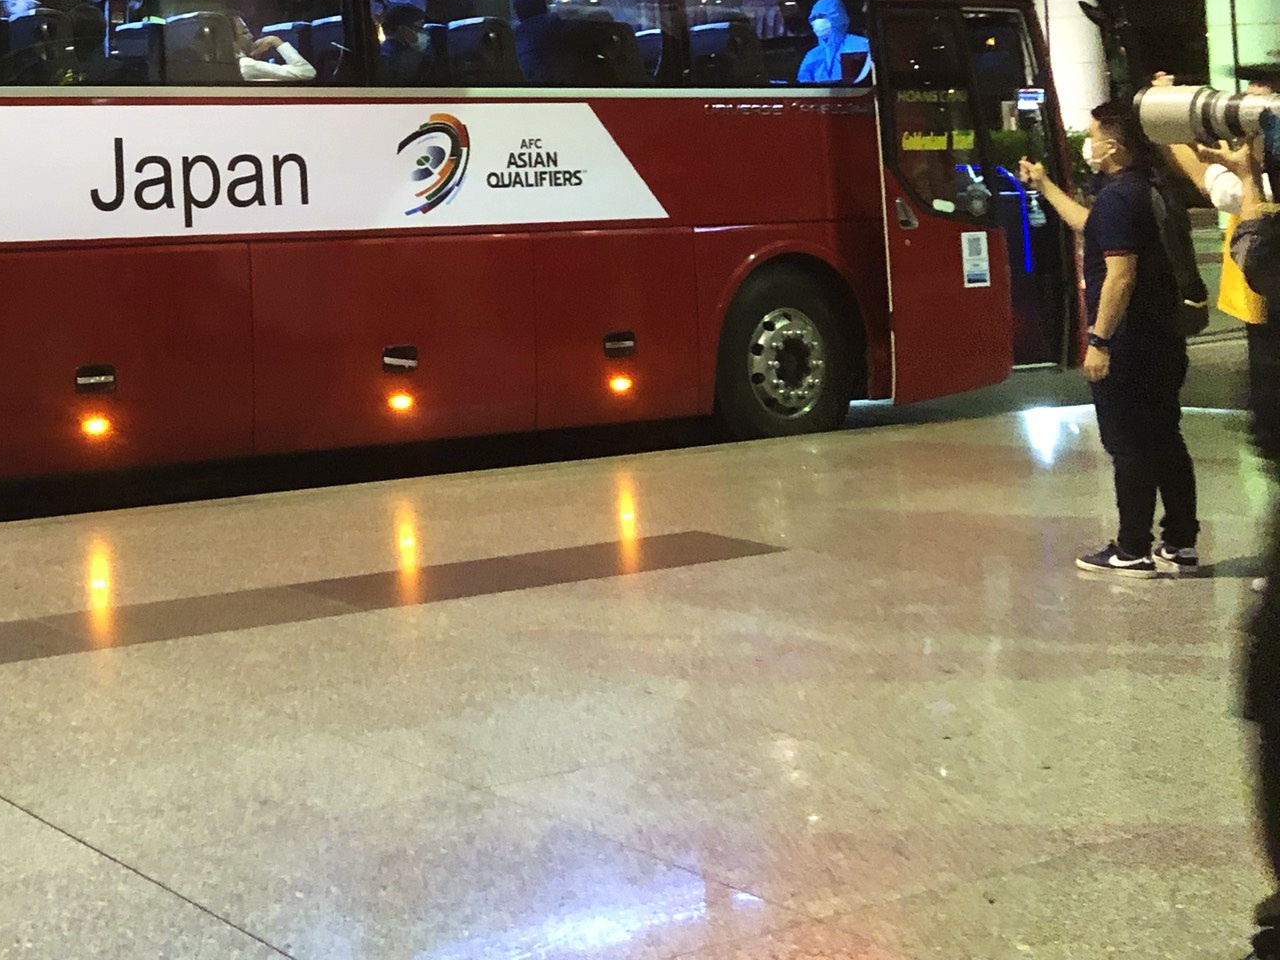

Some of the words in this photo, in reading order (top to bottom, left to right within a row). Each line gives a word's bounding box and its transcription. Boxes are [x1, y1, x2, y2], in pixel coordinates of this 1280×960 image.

[520, 138, 542, 149] AFC
[507, 152, 558, 168] ASIAN
[89, 137, 310, 228] Japan
[487, 170, 583, 189] QUALIFIERS
